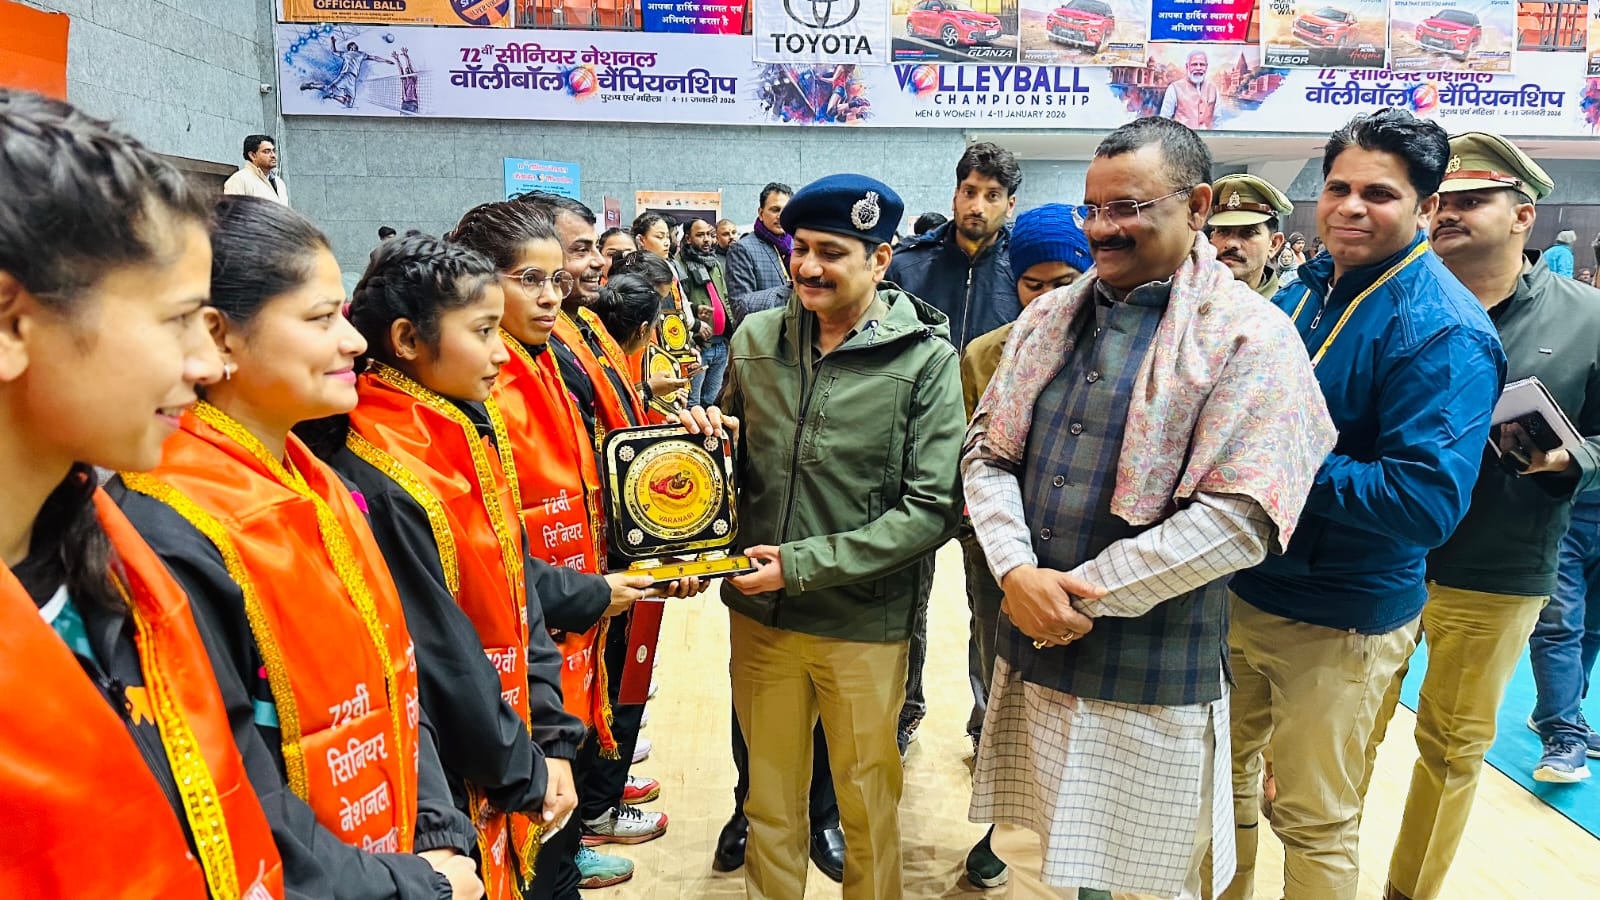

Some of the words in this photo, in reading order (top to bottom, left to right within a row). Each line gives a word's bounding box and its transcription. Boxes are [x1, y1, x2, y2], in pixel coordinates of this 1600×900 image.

[316, 0, 370, 9] OFFICIAL
[373, 0, 403, 10] BALL
[676, 1, 700, 11] हार्दिक
[730, 4, 743, 14] एवं
[662, 14, 696, 24] अभिनंदन
[699, 17, 720, 25] करता
[721, 15, 729, 25] है
[1185, 10, 1208, 20] हार्दिक
[1236, 12, 1249, 22] एवं
[1227, 22, 1234, 33] है
[770, 33, 872, 55] TOYOTA
[495, 42, 577, 64] सीनियर
[581, 45, 658, 68] नेशनल
[968, 49, 1013, 57] GLANZA
[1267, 55, 1309, 64] TAISOR
[449, 63, 563, 91] वॉलीबॉल
[597, 65, 738, 95] चैंपियनशिप
[623, 93, 635, 102] एवं
[636, 93, 661, 103] महिला
[934, 94, 1090, 106] CHAMPIONSHIP
[1305, 81, 1414, 108] वॉलीबॉल
[1438, 83, 1565, 108] चैंपियनशिप
[915, 110, 933, 118] MEN
[943, 110, 976, 118] WOMEN
[1004, 110, 1044, 118] JANUARY
[1046, 110, 1066, 118] 2026
[659, 512, 695, 524] VARANASI
[326, 732, 388, 786] सिनियर
[339, 781, 390, 832] नेशनल
